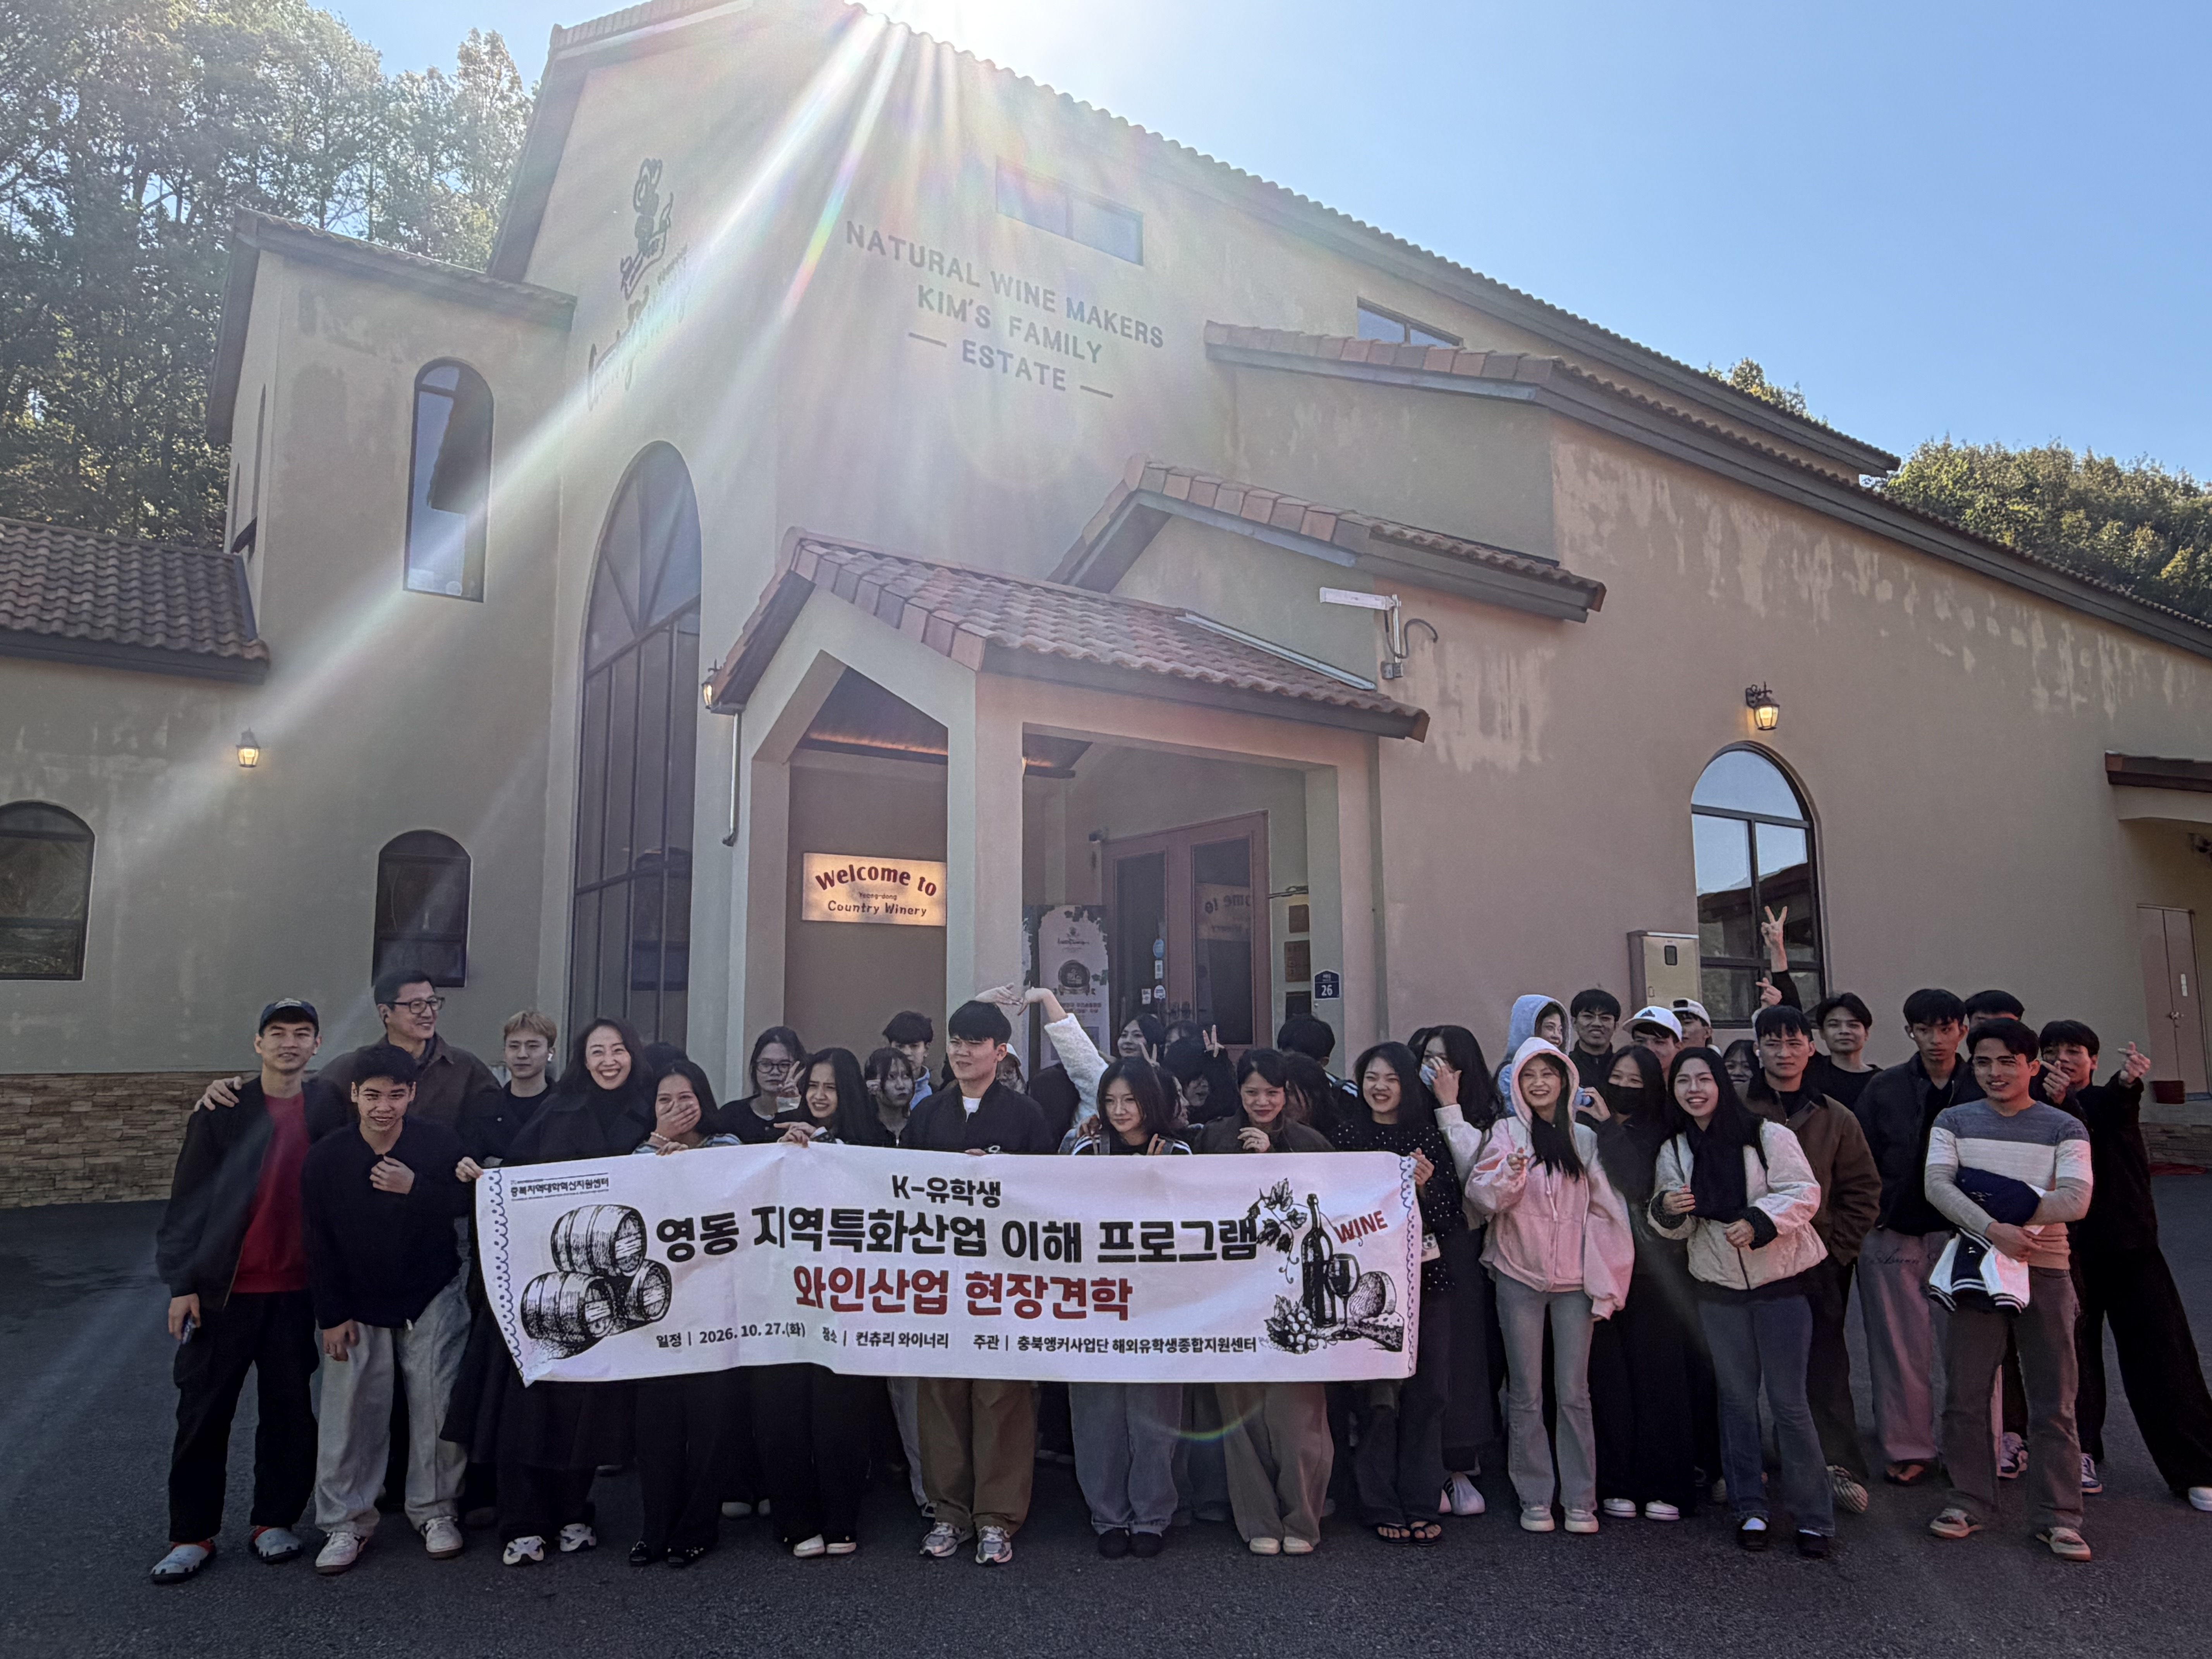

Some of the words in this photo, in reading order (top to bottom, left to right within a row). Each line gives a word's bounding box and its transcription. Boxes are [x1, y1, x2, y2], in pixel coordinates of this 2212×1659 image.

[846, 220, 981, 288] NATURAL
[990, 270, 1056, 313] WINE
[1066, 297, 1164, 348] MAKERS
[918, 284, 991, 329] KIM'S
[1009, 315, 1103, 364] FAMILY
[962, 339, 1066, 392] ESTATE
[815, 864, 911, 891] Welcome
[917, 876, 937, 896] to
[828, 900, 879, 914] Country
[885, 903, 927, 917] Winery
[1321, 984, 1333, 996] 26
[892, 1175, 1001, 1208] K-유학생
[656, 1211, 740, 1262] 영동
[751, 1205, 987, 1257] 지역특화산업
[1002, 1221, 1082, 1263] 이해
[1097, 1219, 1257, 1263] 프로그램
[1333, 1210, 1388, 1244] WINE
[793, 1266, 949, 1315] 와인산업
[965, 1271, 1133, 1321] 현장견학
[656, 1332, 682, 1348] 일정
[822, 1327, 837, 1343] 장소
[856, 1331, 895, 1347] 컨츄리
[898, 1332, 949, 1349] 와이너리
[973, 1334, 1000, 1350] 주관
[1017, 1336, 1109, 1353] 충북앵커사업단
[1112, 1337, 1257, 1354] 해외유학생종합지원센터
